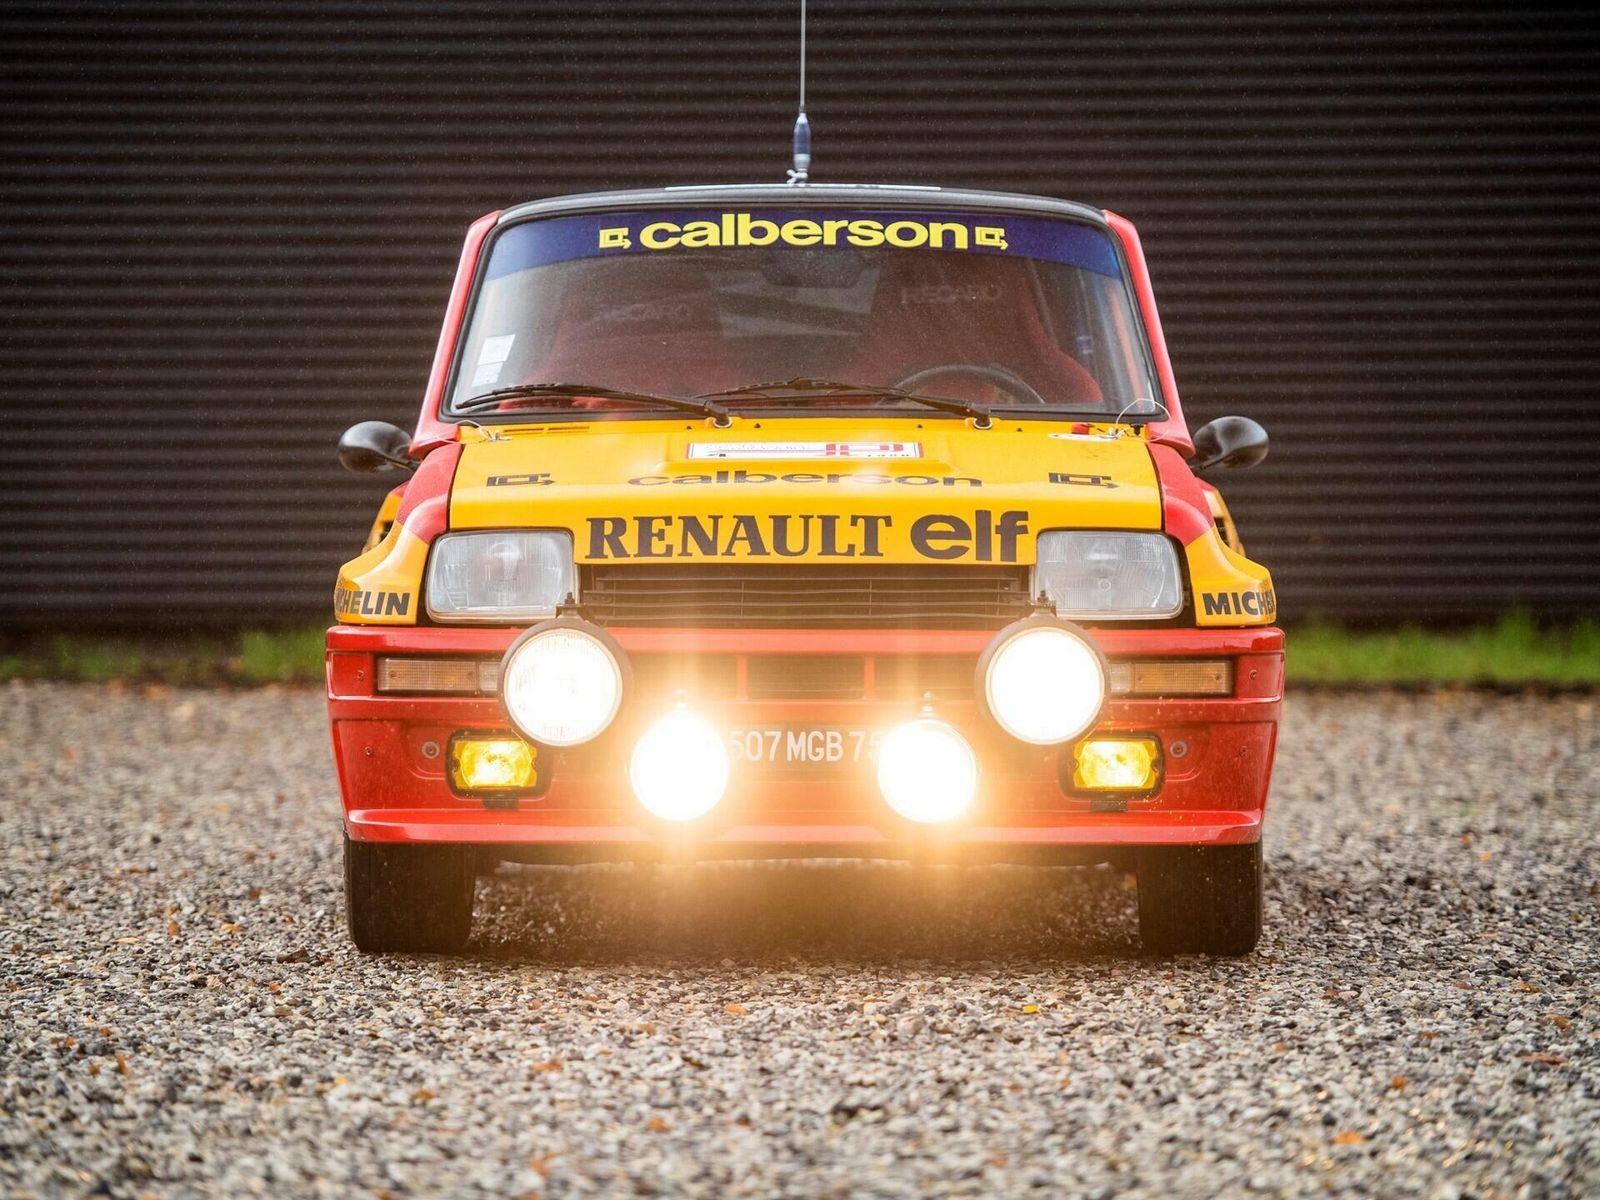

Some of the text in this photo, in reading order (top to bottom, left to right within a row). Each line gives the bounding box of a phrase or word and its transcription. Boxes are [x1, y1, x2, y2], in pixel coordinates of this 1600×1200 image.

[639, 213, 969, 250] calberson
[627, 470, 983, 488] calberson
[585, 509, 1029, 562] RENAULT elf
[336, 588, 410, 616] HELIN
[786, 731, 844, 762] MGB
